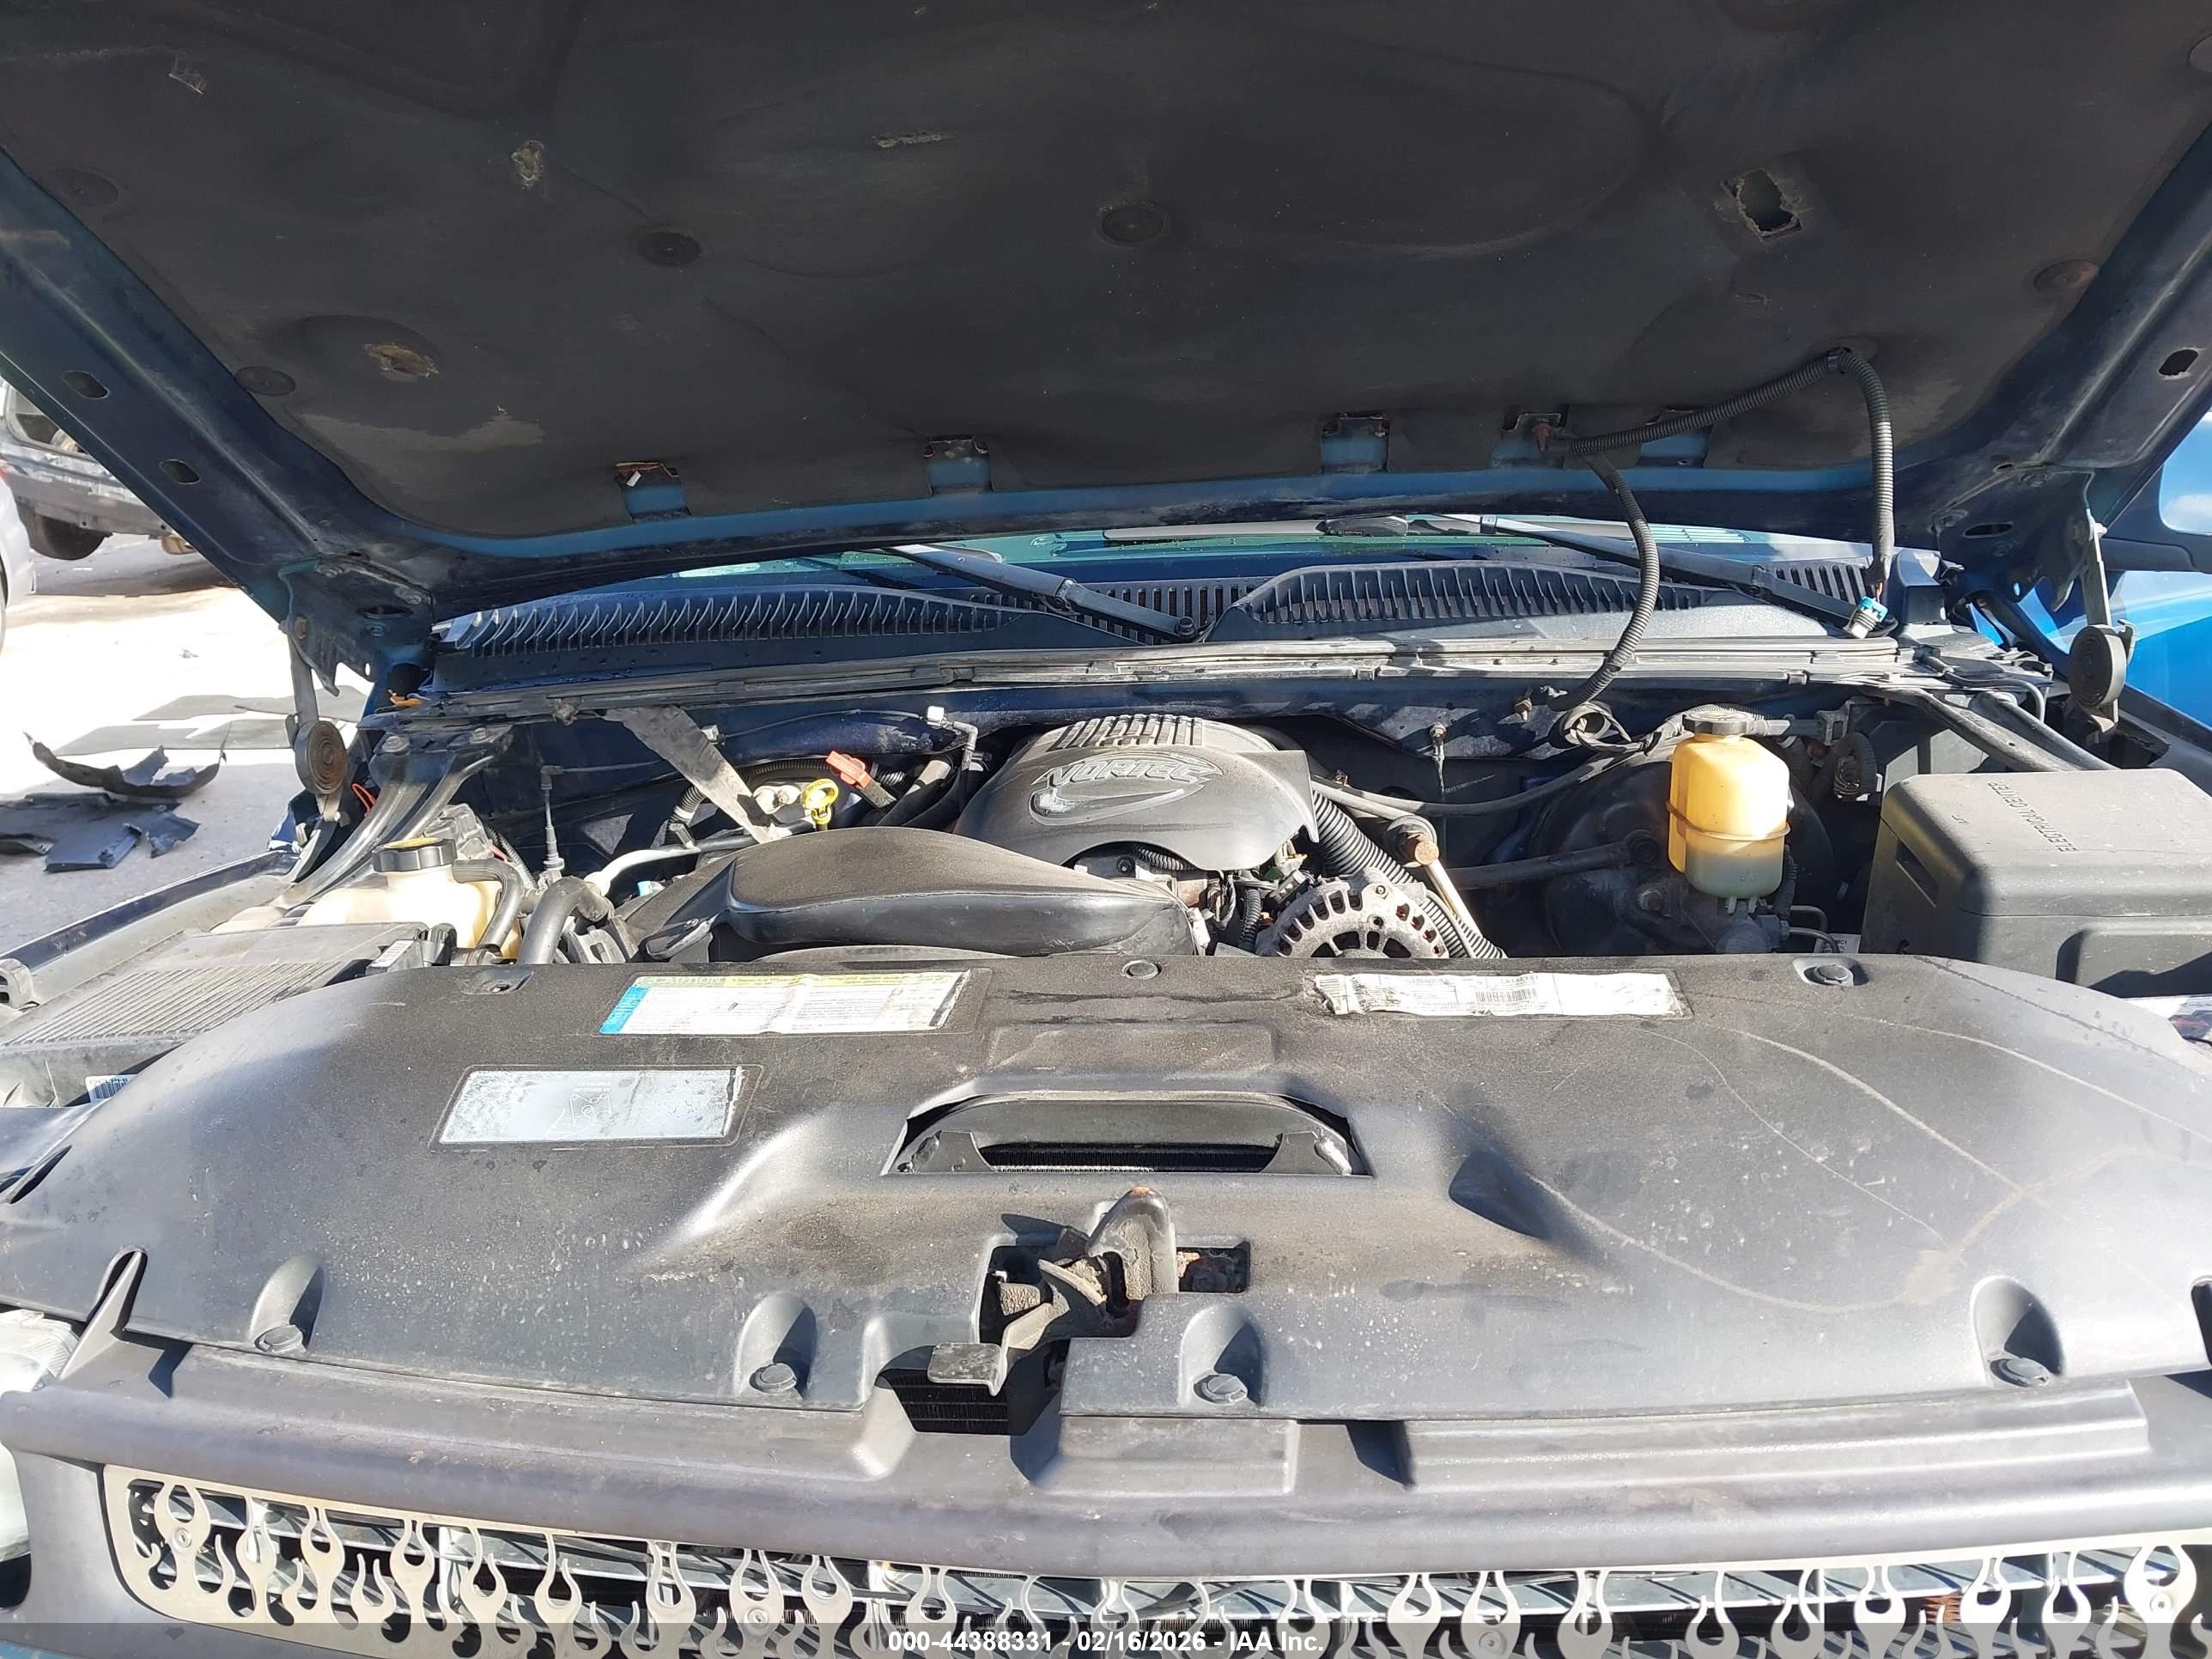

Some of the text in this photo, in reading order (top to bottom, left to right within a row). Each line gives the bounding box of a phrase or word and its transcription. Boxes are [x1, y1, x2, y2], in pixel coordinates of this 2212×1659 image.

[1042, 759, 1212, 787] VORTEC
[1987, 782, 2080, 853] ELECTRICAL CENTER
